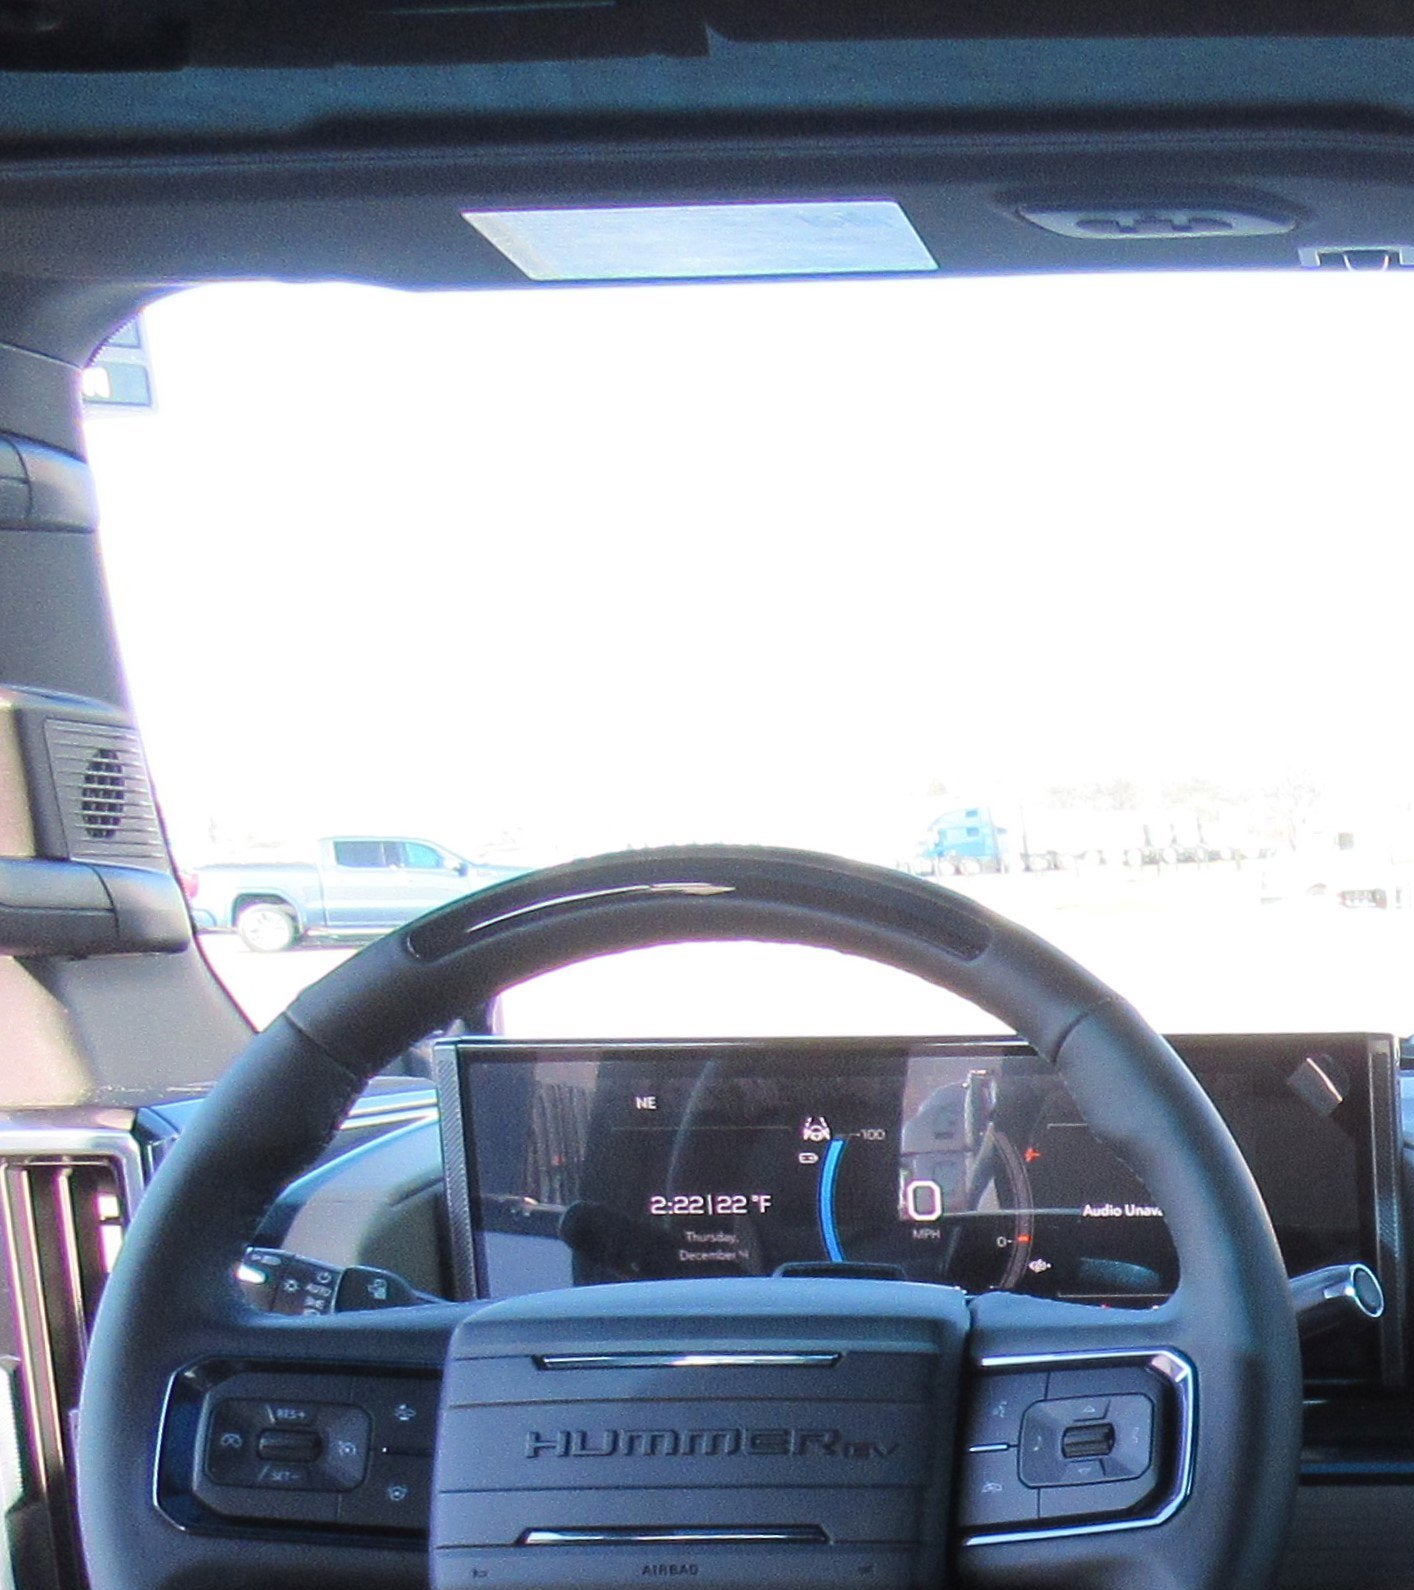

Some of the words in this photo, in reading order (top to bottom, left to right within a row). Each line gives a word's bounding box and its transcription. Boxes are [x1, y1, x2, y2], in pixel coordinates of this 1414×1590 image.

[635, 1096, 657, 1110] NE
[904, 1177, 944, 1223] 0
[1082, 1203, 1123, 1217] Audio
[912, 1228, 941, 1239] MPH
[678, 1248, 737, 1262] December
[525, 1428, 841, 1459] HUMMER
[641, 1563, 700, 1577] AIRBAG
